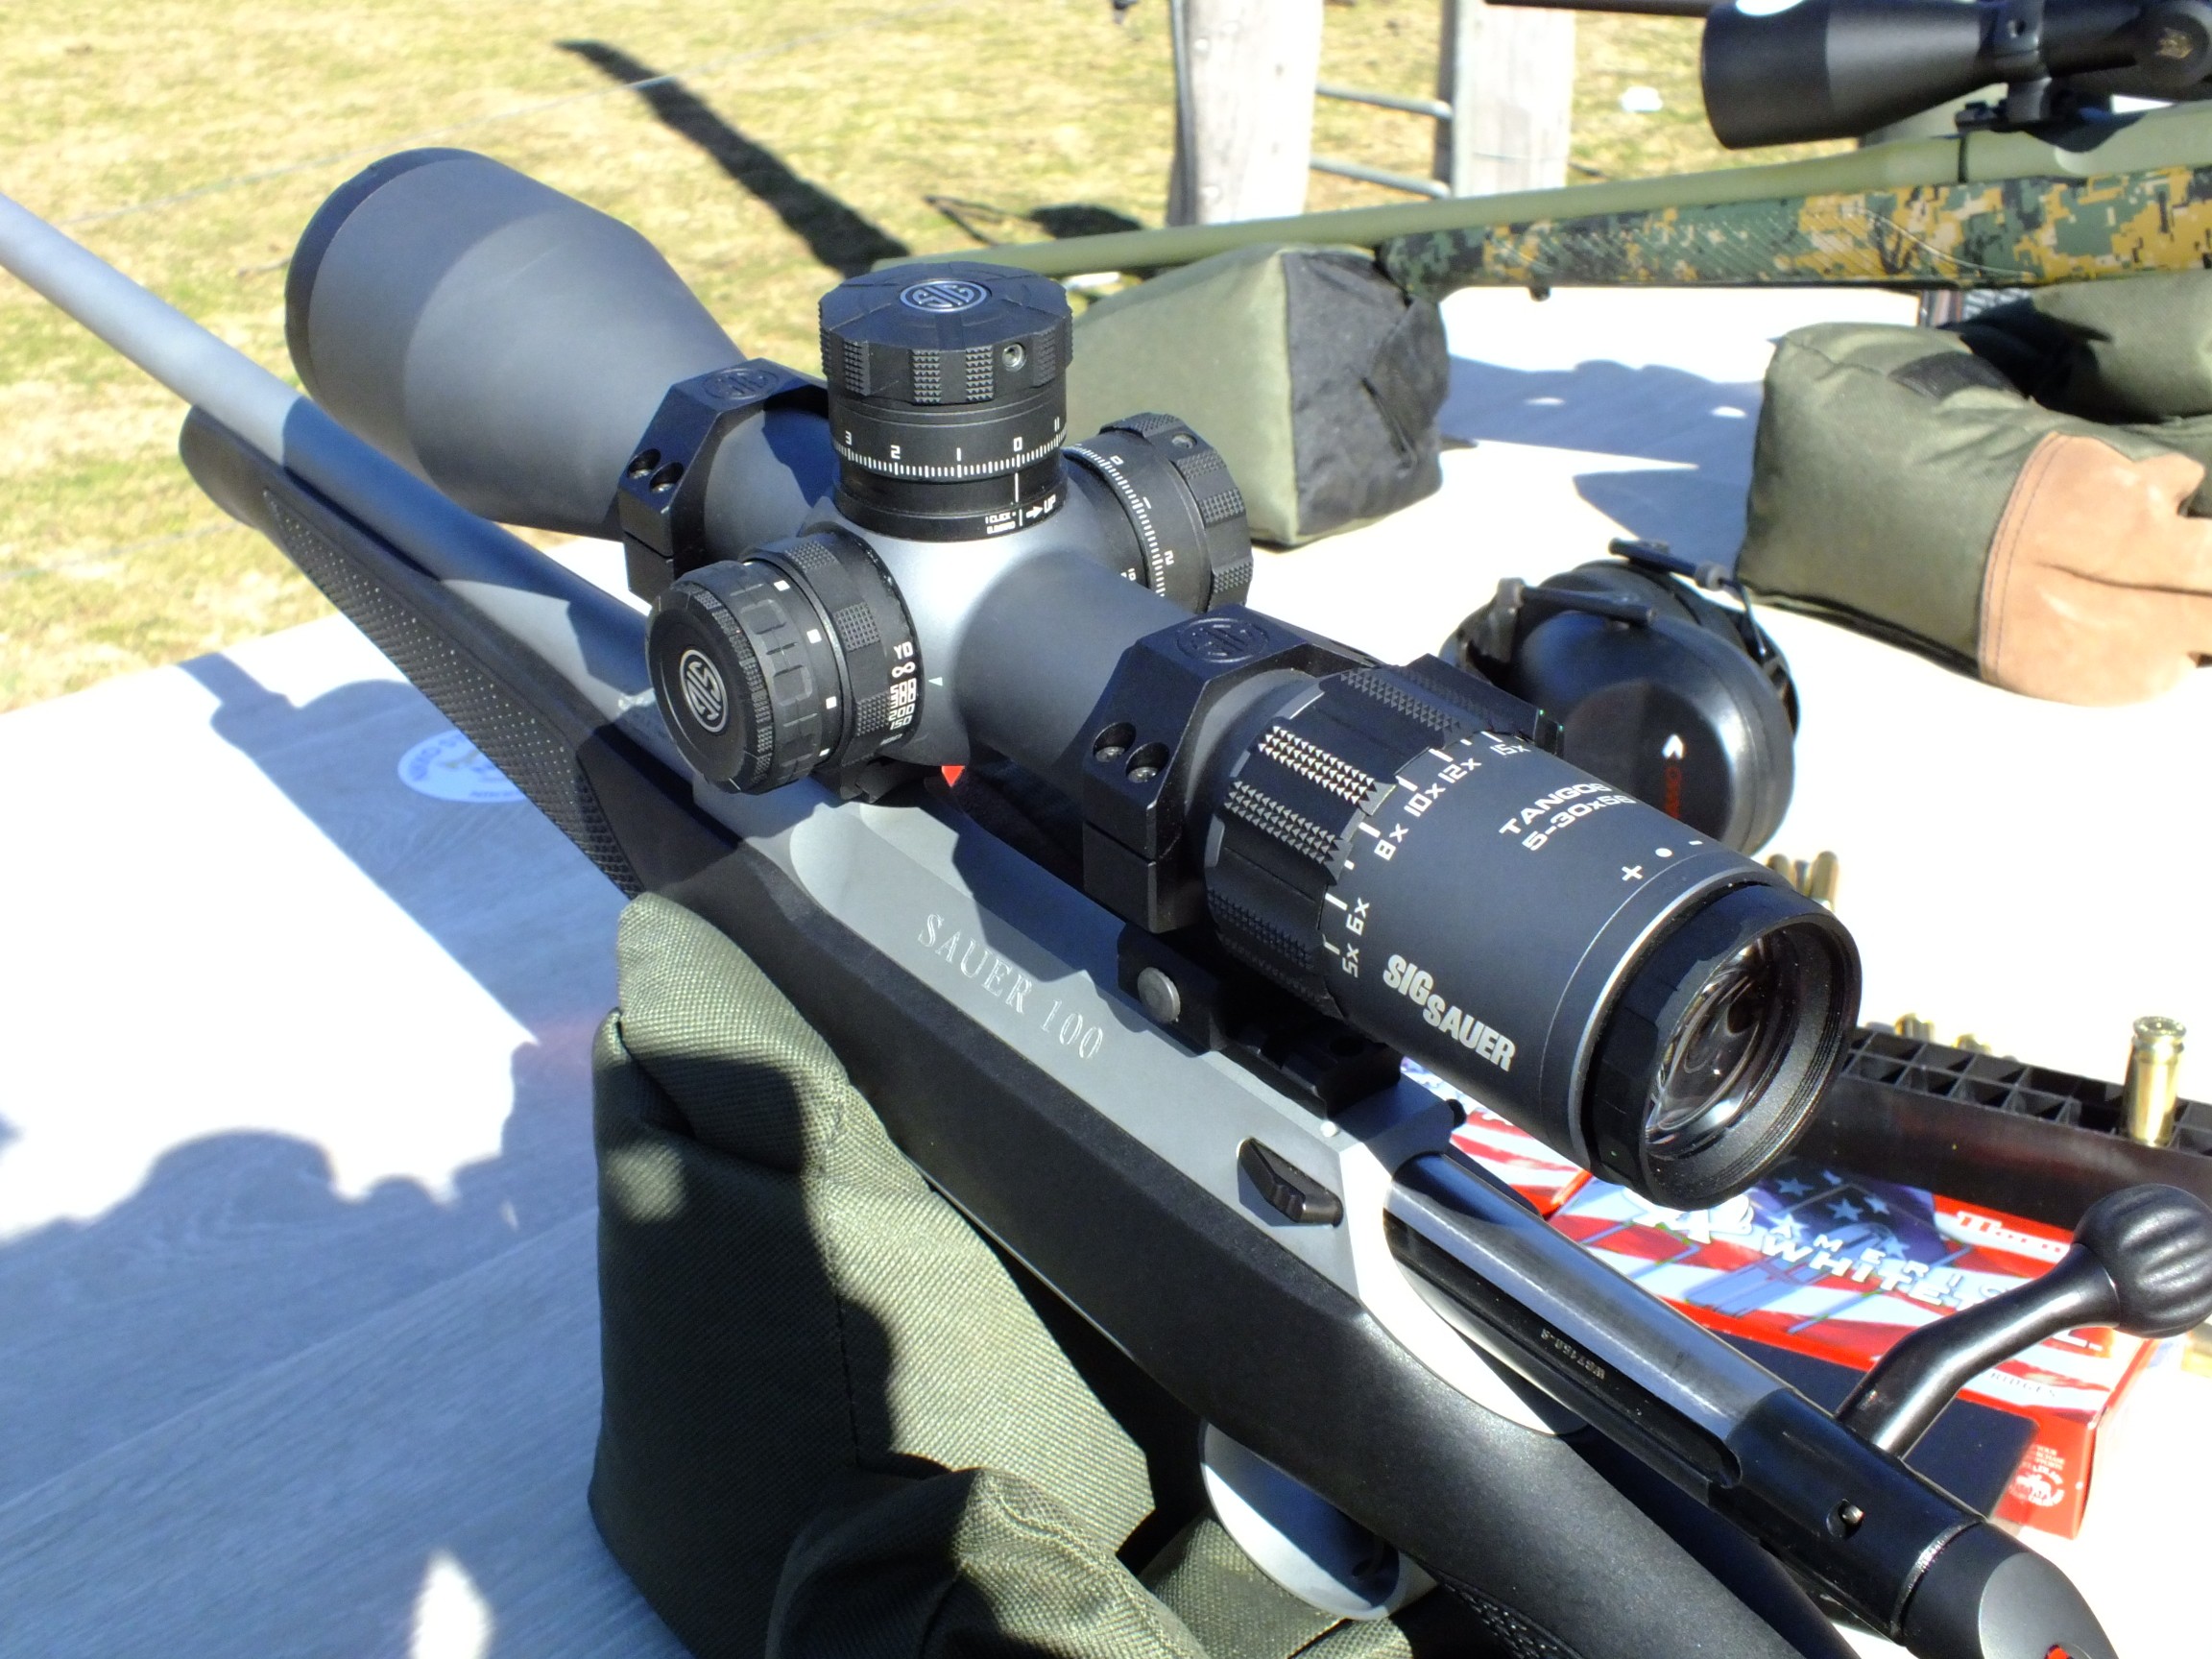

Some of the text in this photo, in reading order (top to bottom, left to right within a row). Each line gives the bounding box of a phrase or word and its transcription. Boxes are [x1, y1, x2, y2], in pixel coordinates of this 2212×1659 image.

[845, 431, 852, 445] 3
[891, 445, 901, 459] 2
[956, 447, 961, 461] 1
[1013, 437, 1022, 452] 0
[1044, 494, 1056, 514] UP
[1164, 550, 1174, 565] 2
[893, 640, 913, 660] YD
[888, 702, 915, 722] 200
[889, 714, 913, 730] 150
[1522, 795, 1636, 851] 5-30x56
[918, 914, 1103, 1059] SAUER 100
[1382, 953, 1516, 1072] SIG SAUER
